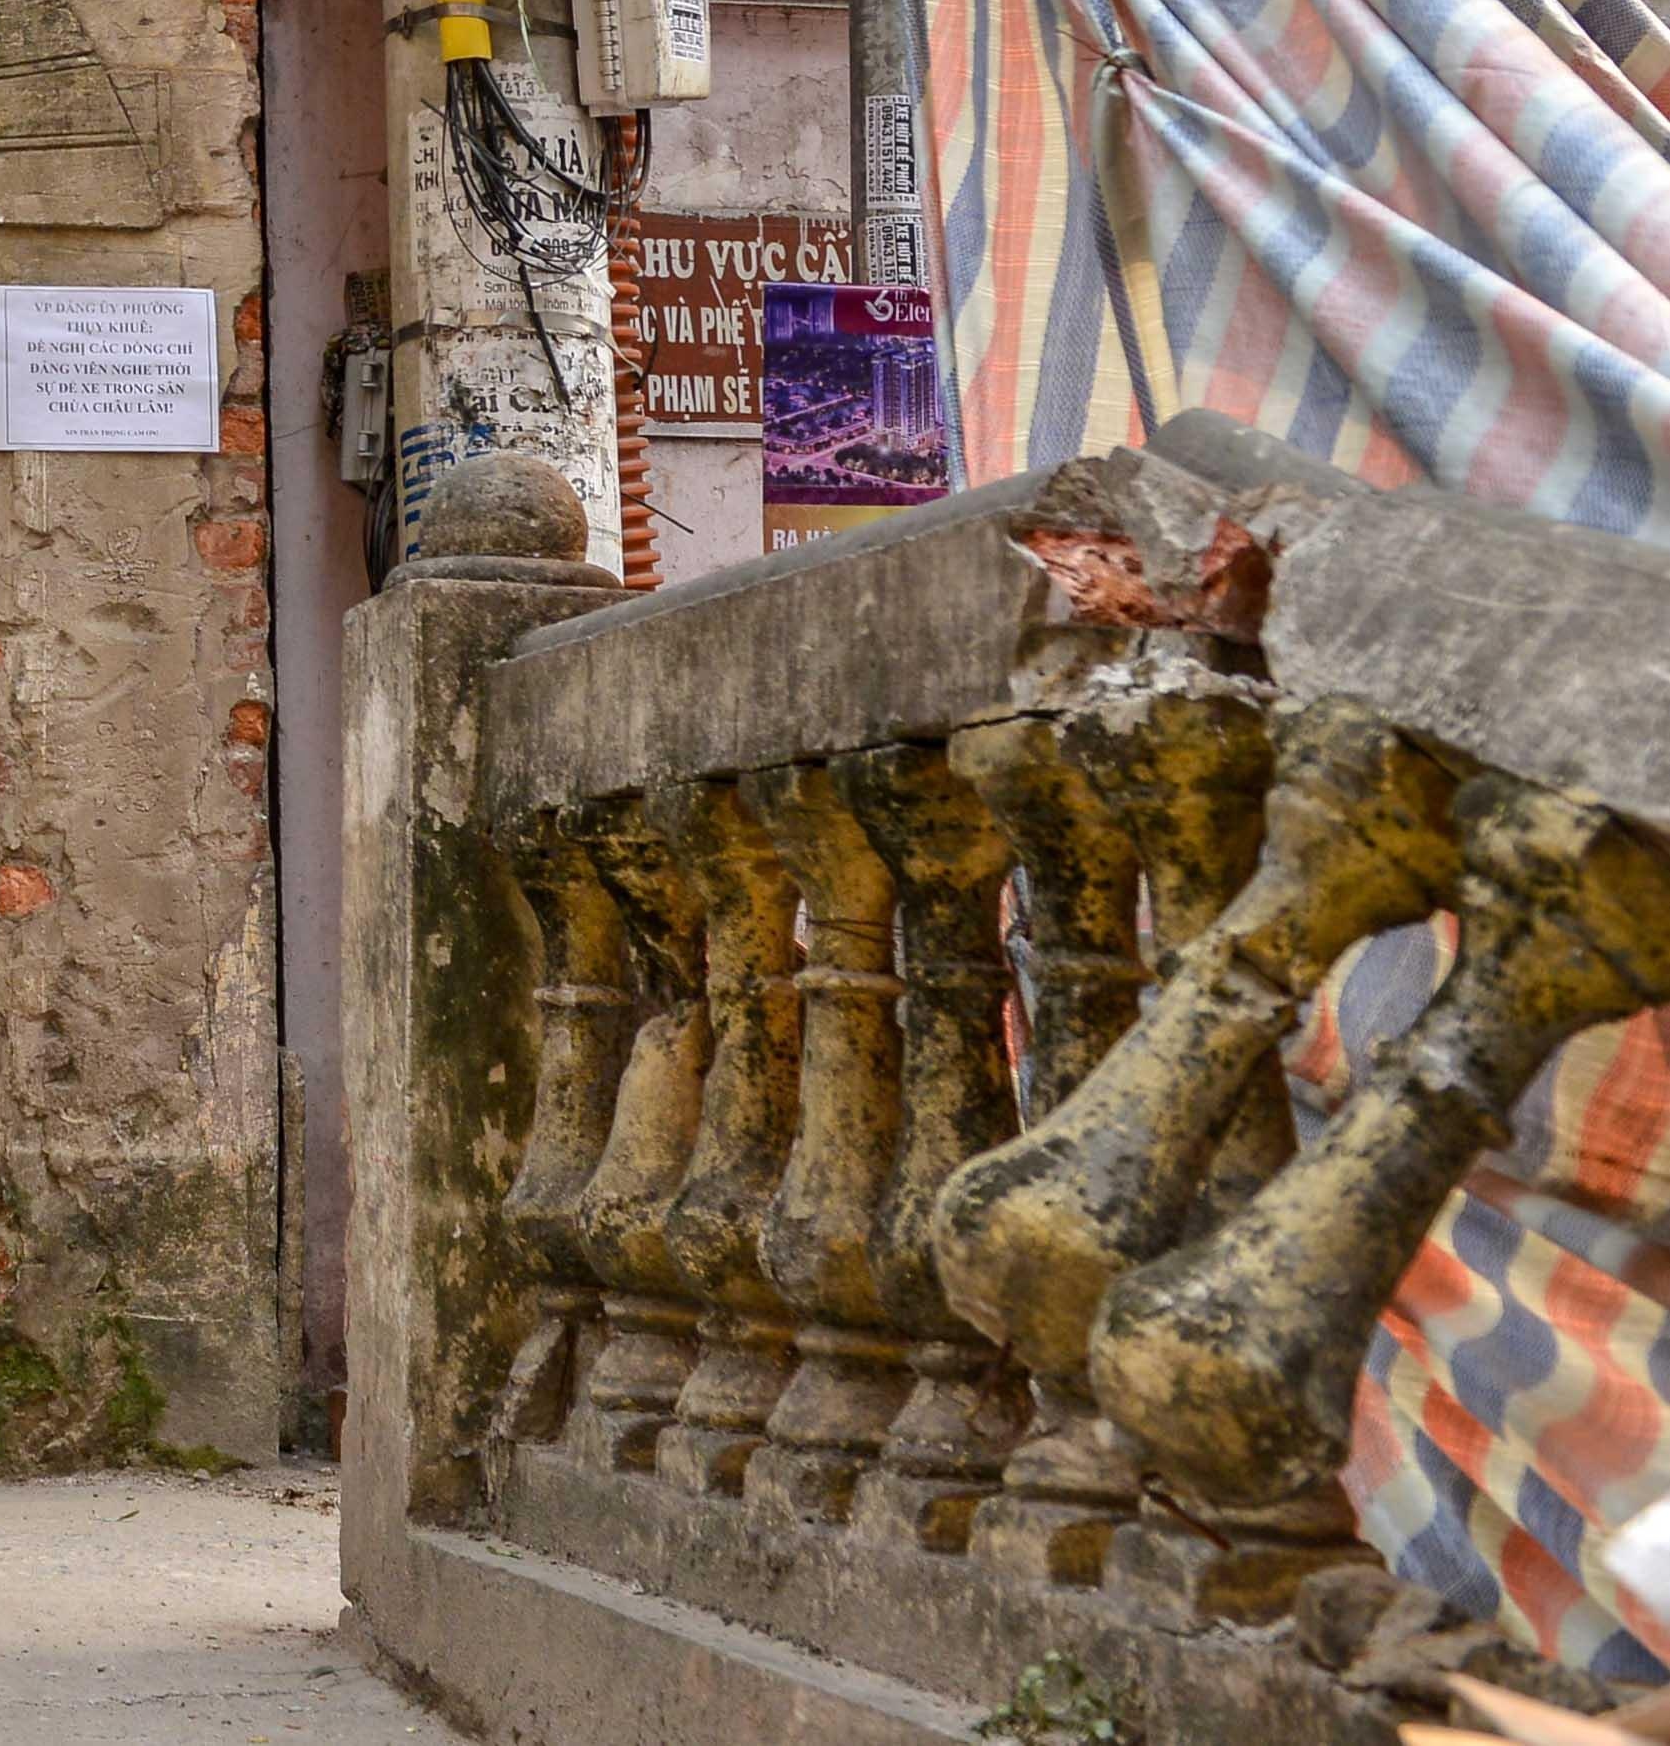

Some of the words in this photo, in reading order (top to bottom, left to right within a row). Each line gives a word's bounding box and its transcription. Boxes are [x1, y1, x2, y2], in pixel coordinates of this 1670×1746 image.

[895, 104, 909, 121] XE
[895, 122, 911, 143] HÚT
[881, 105, 895, 193] 0943.151.442
[895, 163, 915, 194] PHỐT
[896, 223, 910, 240] XE
[896, 241, 912, 263] HÚT
[705, 238, 787, 290] VỰC
[122, 300, 184, 315] PHƯỜNG
[66, 320, 103, 336] THỤY
[108, 319, 153, 335] KHUÊ:
[663, 296, 695, 344] VÀ
[49, 341, 86, 357] NGHỊ
[89, 340, 119, 354] CÁC
[166, 340, 193, 355] CHÍ
[72, 361, 108, 376] VIÊN
[111, 363, 152, 376] NGHE
[155, 362, 192, 376] THỜI
[81, 382, 101, 394] XE
[104, 383, 154, 394] TRONG
[157, 380, 186, 394] SÂN
[647, 374, 716, 420] PHẠM
[722, 367, 752, 415] SẼ
[48, 399, 89, 414] CHÙA
[93, 400, 133, 414] CHÂU
[137, 400, 174, 414] LÂM!
[771, 528, 799, 551] RA
